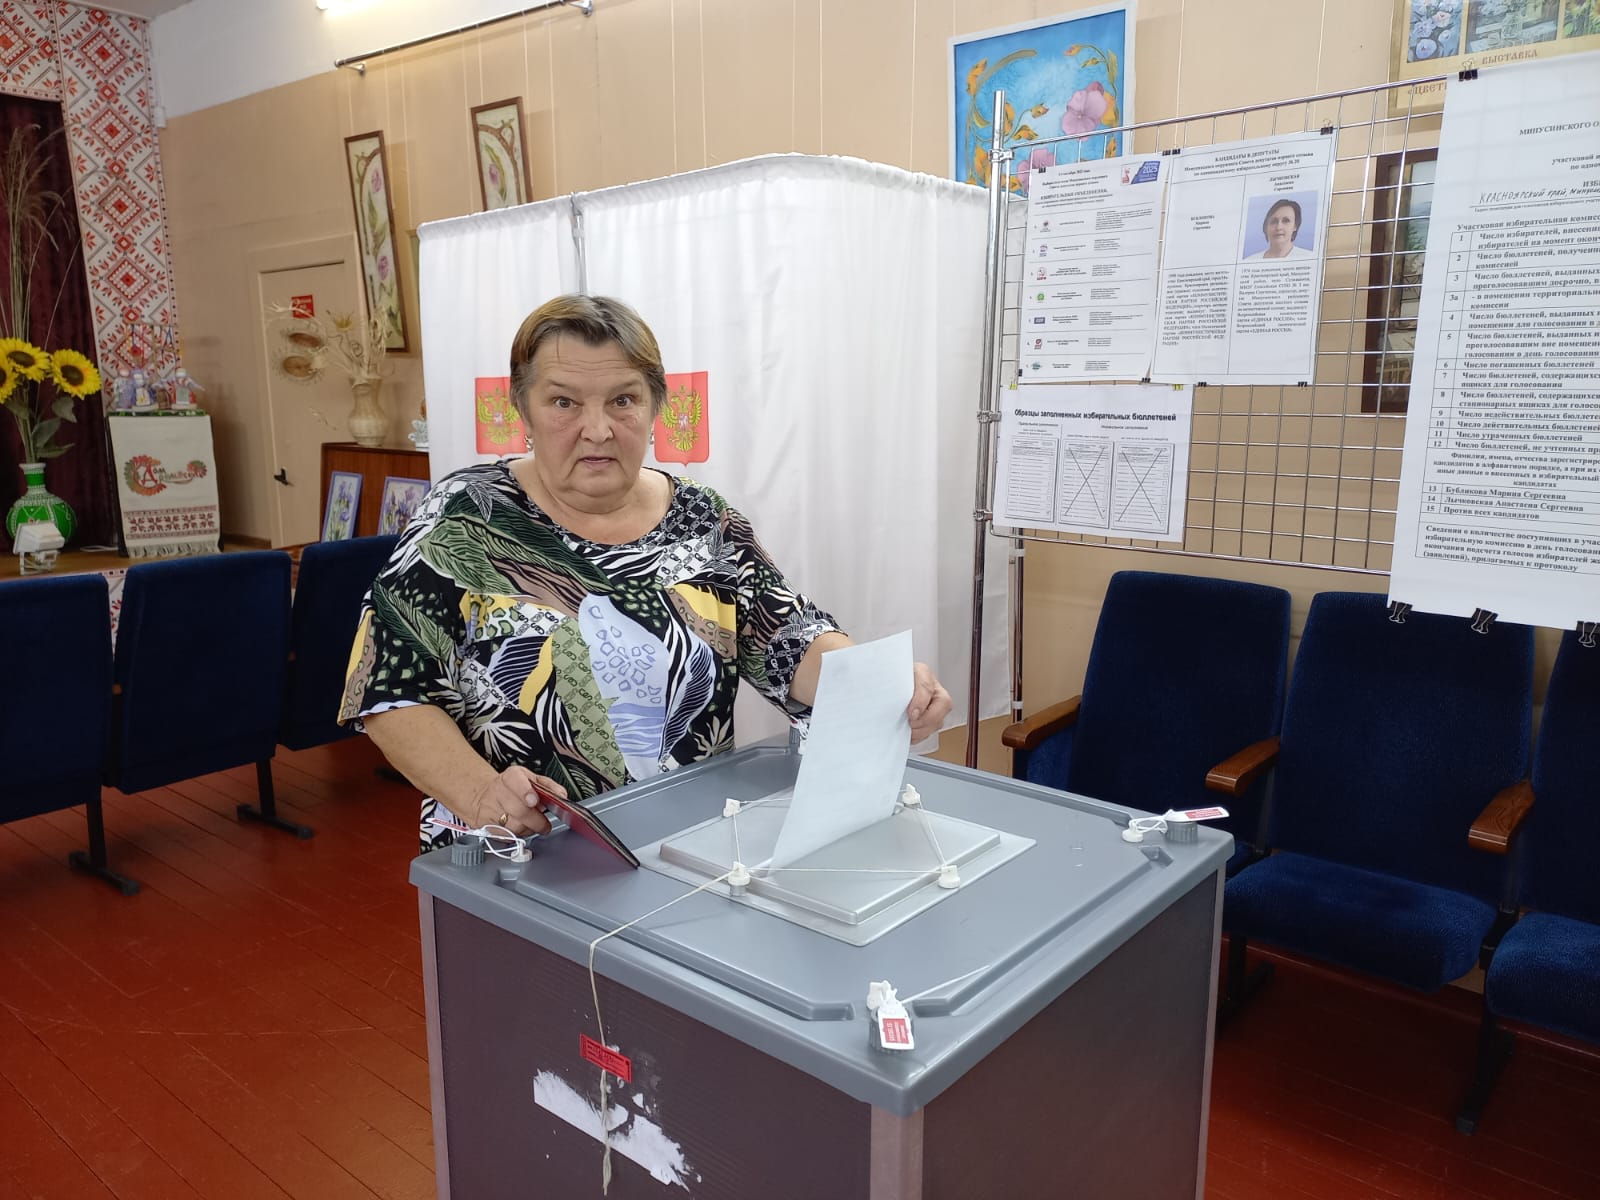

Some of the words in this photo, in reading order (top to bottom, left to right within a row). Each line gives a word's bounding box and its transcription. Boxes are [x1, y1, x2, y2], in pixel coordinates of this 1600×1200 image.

[1482, 49, 1538, 65] ВЫСТАВКА
[1519, 121, 1591, 135] МИНУСИНСКОГО
[1552, 154, 1593, 165] участковой
[1457, 222, 1503, 231] Участковая
[1506, 217, 1568, 227] избирательная
[1480, 232, 1504, 240] Число
[1507, 228, 1560, 238] избирателей,
[1478, 240, 1528, 250] избирателей
[1543, 237, 1574, 245] момент
[1477, 251, 1501, 260] Число
[1504, 249, 1555, 259] бюллетеней,
[1476, 261, 1518, 269] комиссией
[1474, 272, 1499, 280] Число
[1501, 270, 1552, 279] бюллетеней,
[1473, 281, 1547, 290] проголосовавшим
[1550, 278, 1591, 287] досрочно,
[1484, 292, 1530, 300] помещении
[1469, 312, 1494, 320] Число
[1496, 311, 1547, 319] бюллетеней,
[1465, 342, 1539, 350] проголосовавшим
[1488, 371, 1539, 379] бюллетеней,
[1486, 391, 1537, 399] бюллетеней,
[1459, 401, 1516, 409] стационарных
[1014, 409, 1039, 418] Образцы
[1041, 410, 1082, 419] заполненных
[1083, 411, 1131, 421] избирательных
[1132, 412, 1176, 422] бюллетеней
[1484, 411, 1560, 419] недействительных
[1483, 422, 1550, 430] действительных
[1482, 433, 1530, 441] утраченных
[1532, 433, 1583, 441] бюллетеней
[1480, 442, 1530, 450] бюллетеней,
[1481, 462, 1527, 470] алфавитном
[1539, 473, 1599, 481] избирательный
[1446, 486, 1487, 495] Бубликова
[1490, 489, 1521, 498] Марина
[1523, 491, 1566, 500] Сергеевна
[1444, 497, 1493, 505] Лычковская
[1495, 500, 1538, 509] Анастасия
[1540, 502, 1584, 511] Сергеевна
[1443, 506, 1473, 514] Против
[1493, 511, 1540, 519] кандидатов
[1426, 525, 1462, 534] Сведения
[1470, 530, 1515, 538] количестве
[1516, 533, 1572, 543] поступивших
[1425, 534, 1483, 545] избирательную
[1485, 540, 1525, 548] комиссию
[1424, 543, 1464, 551] окончания
[1466, 547, 1501, 555] подсчета
[1503, 550, 1534, 558] голосов
[1536, 553, 1588, 563] избирателей
[1423, 550, 1469, 561] (заявлений),
[1471, 556, 1524, 565] прилагаемых
[1534, 562, 1578, 573] протоколу
